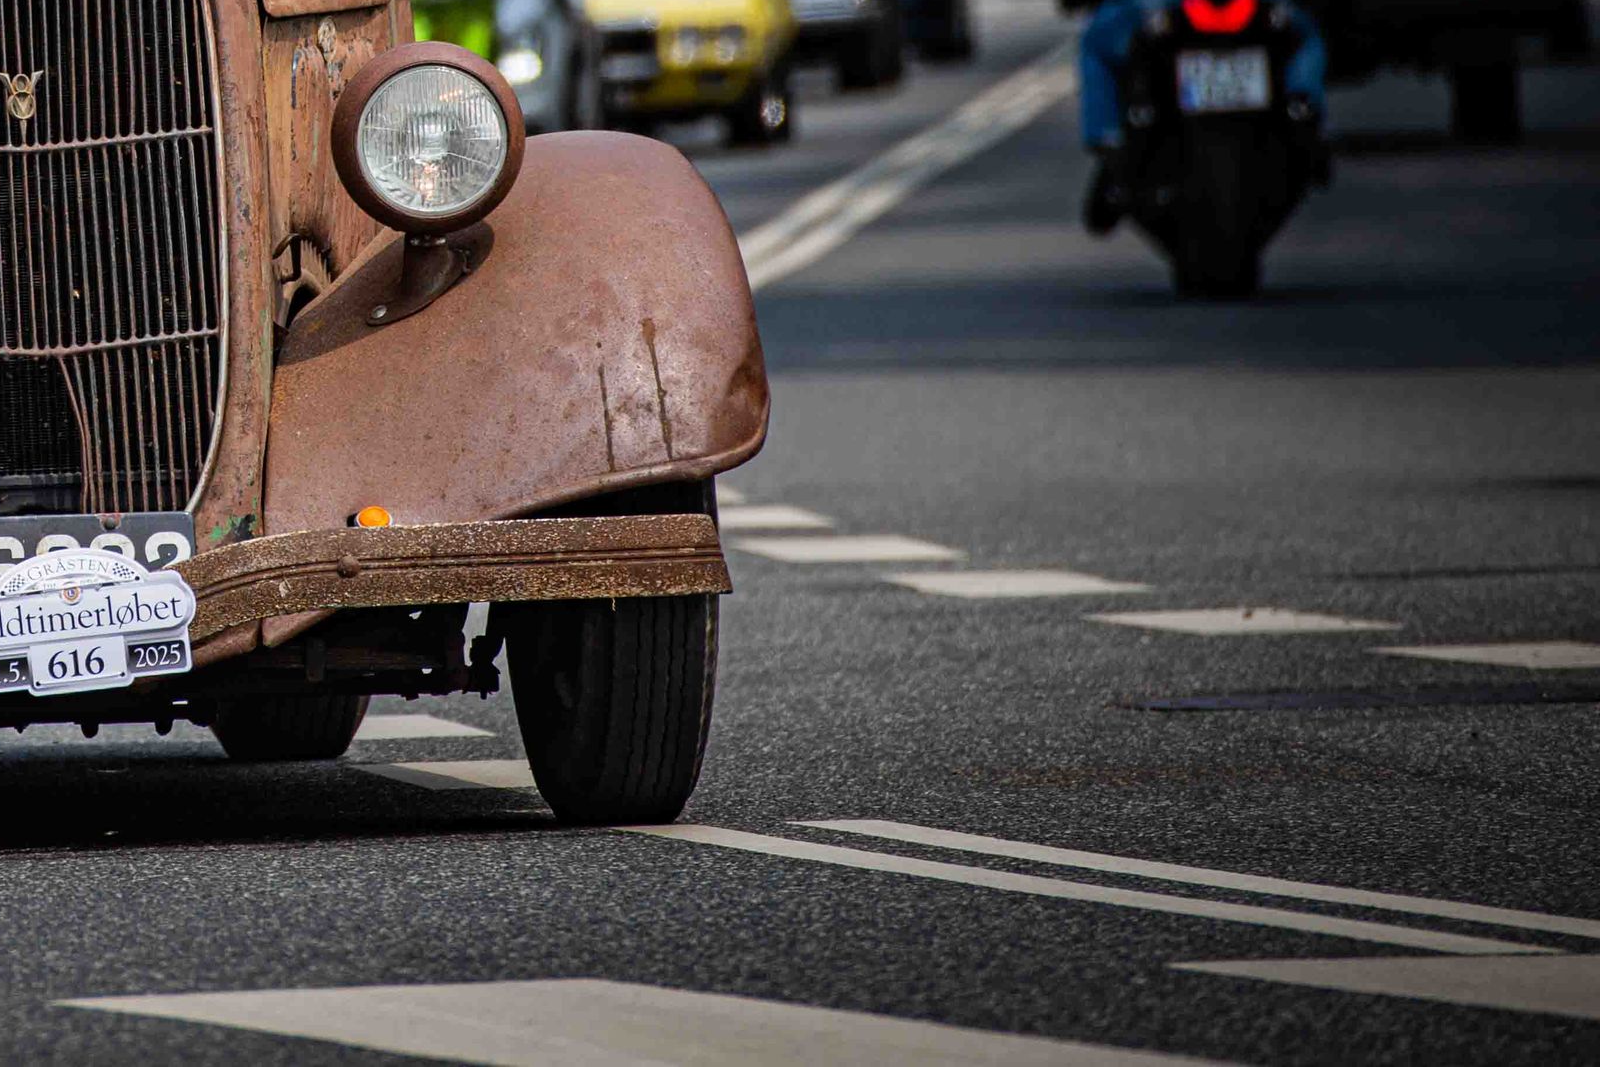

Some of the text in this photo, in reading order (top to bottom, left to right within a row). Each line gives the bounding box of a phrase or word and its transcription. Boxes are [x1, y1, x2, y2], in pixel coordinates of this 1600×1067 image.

[27, 557, 111, 582] GRÅSTEN
[48, 646, 105, 680] 616
[133, 643, 182, 668] 2025
